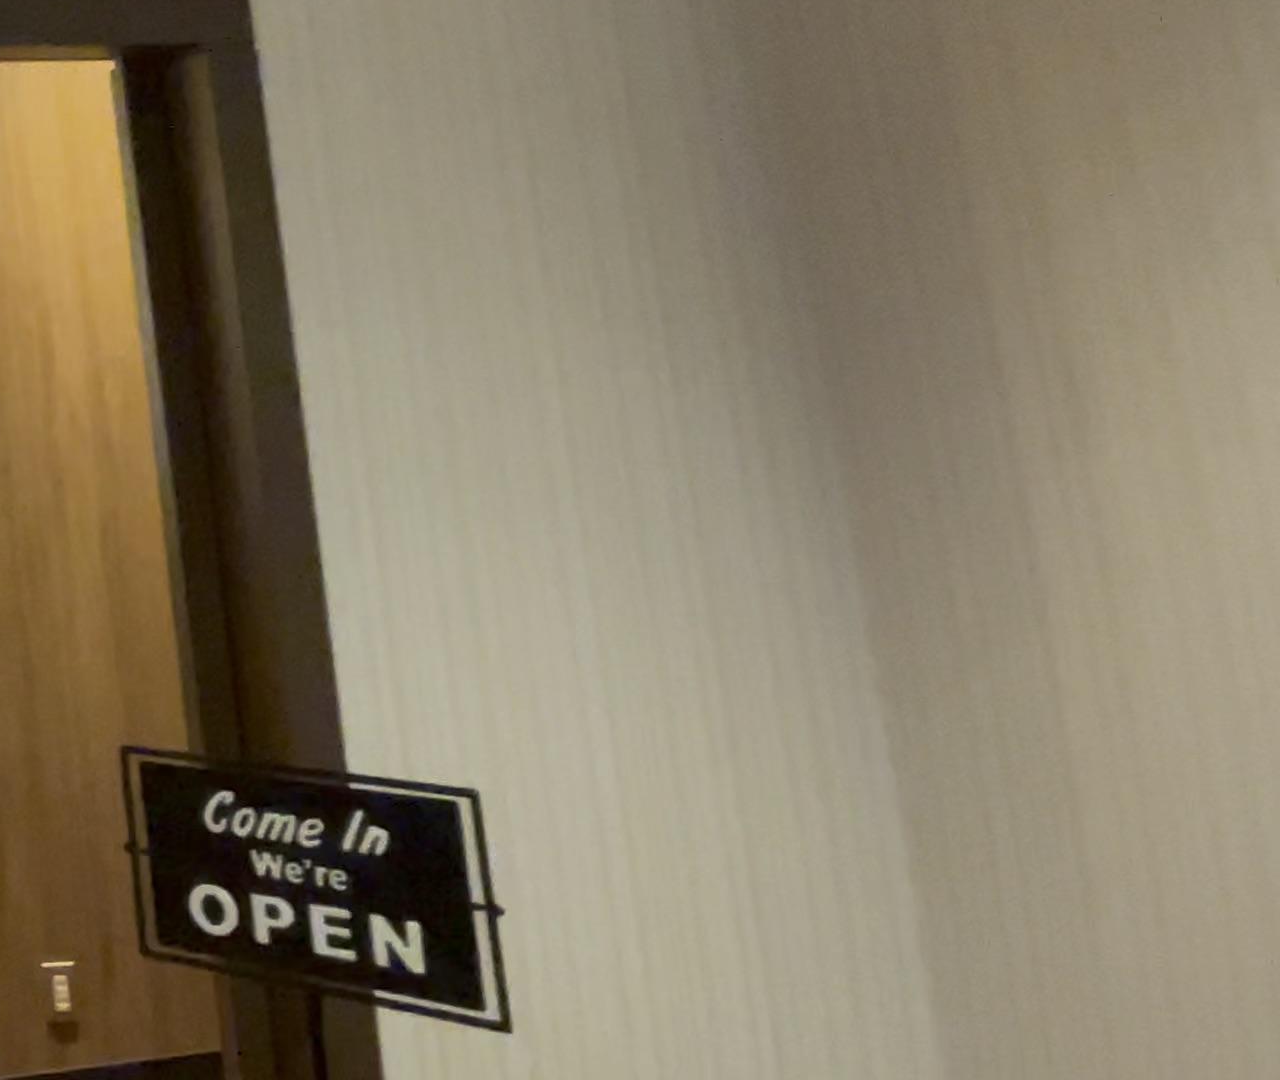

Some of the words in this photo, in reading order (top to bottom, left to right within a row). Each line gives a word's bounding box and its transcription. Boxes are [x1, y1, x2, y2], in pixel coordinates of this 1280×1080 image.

[203, 791, 324, 848] Come
[343, 810, 389, 855] In
[249, 849, 349, 891] We're
[188, 883, 426, 975] OPEN
